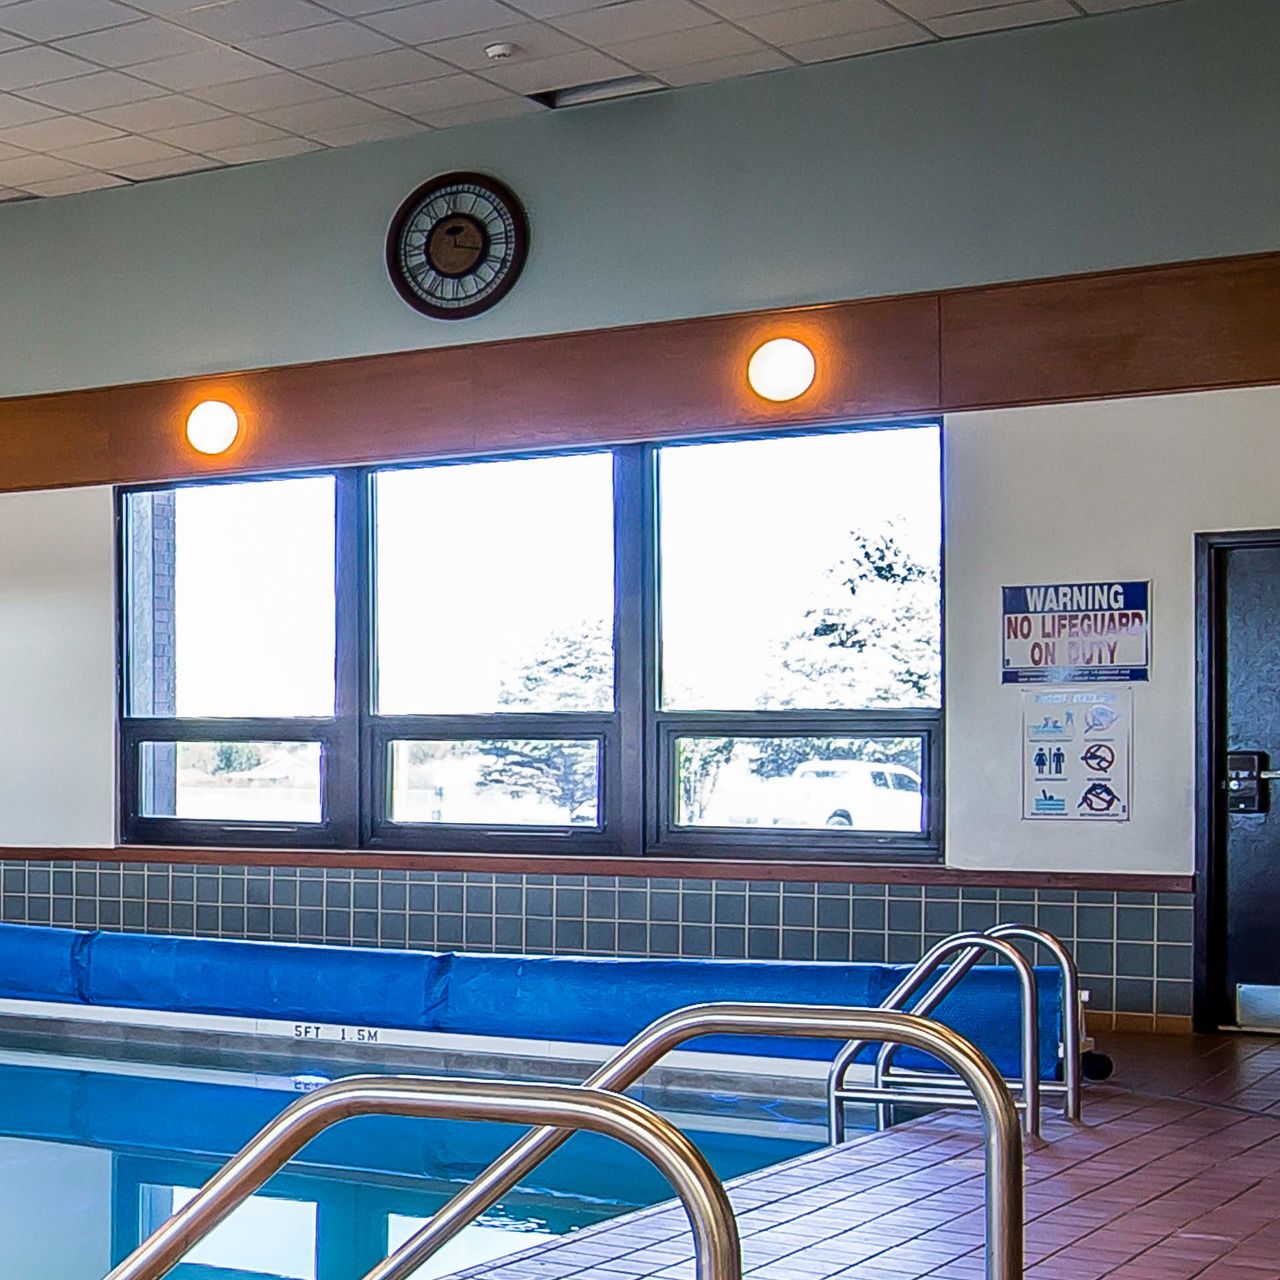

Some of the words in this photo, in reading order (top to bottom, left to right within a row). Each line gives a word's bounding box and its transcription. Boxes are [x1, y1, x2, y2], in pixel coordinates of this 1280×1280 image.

[1025, 584, 1124, 611] WARNING
[1006, 615, 1032, 640] NO
[1041, 612, 1144, 638] LIFEGUARD
[1030, 641, 1056, 666] ON
[1067, 640, 1118, 665] DUTY
[294, 1025, 321, 1038] 5FT
[341, 1028, 378, 1042] 1.5M
